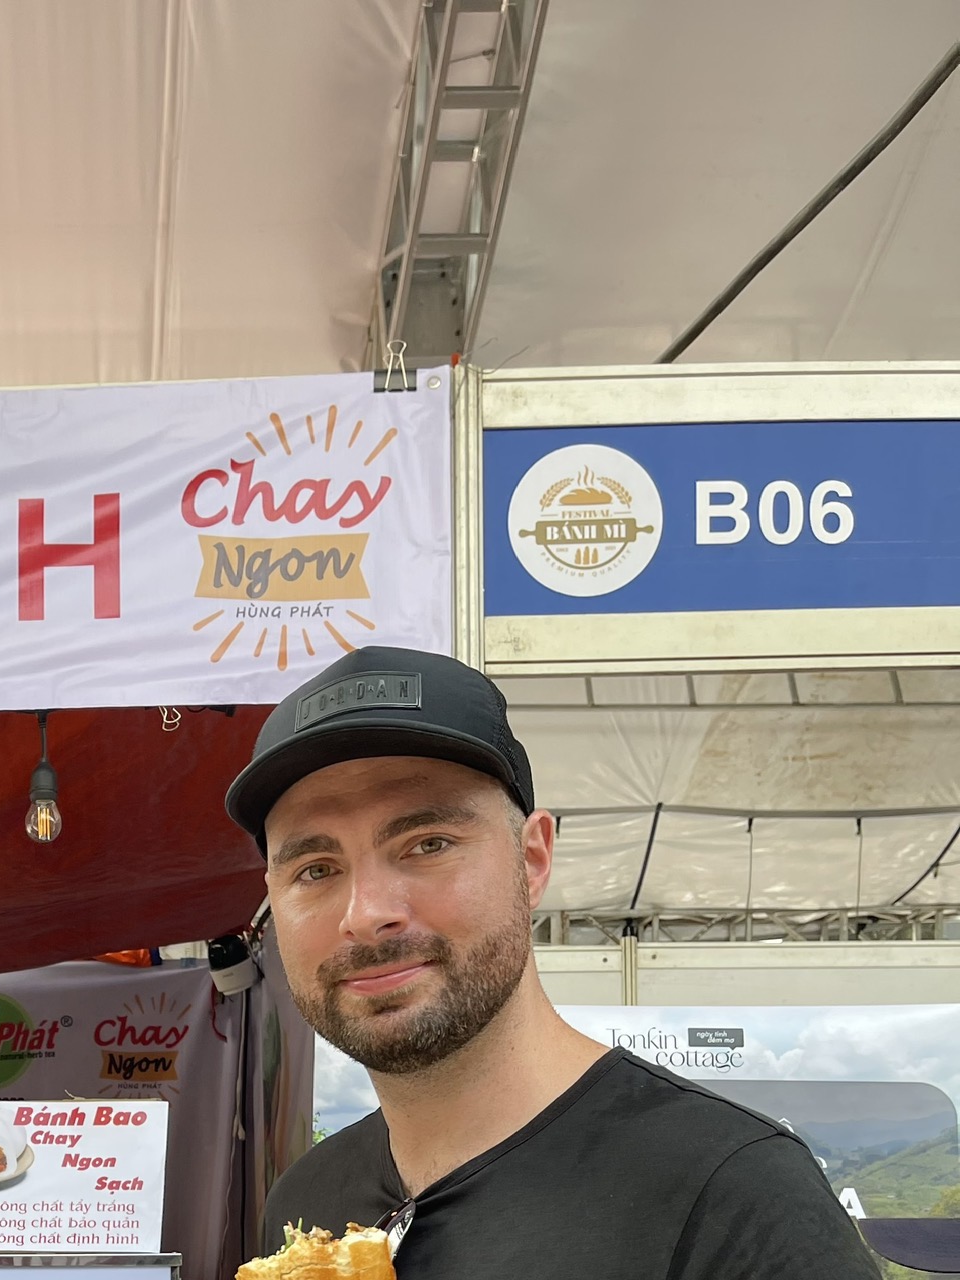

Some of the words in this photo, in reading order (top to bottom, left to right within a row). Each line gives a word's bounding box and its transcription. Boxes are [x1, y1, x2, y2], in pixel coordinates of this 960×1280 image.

[181, 457, 392, 529] Chay
[561, 509, 613, 519] FESTIVAL
[695, 479, 855, 546] B06
[545, 521, 597, 541] BÁNH
[603, 519, 627, 539] MÌ
[212, 541, 356, 599] Ngon
[235, 602, 281, 619] HÙNG
[289, 602, 335, 618] PHÁT
[94, 1015, 189, 1048] Chay
[605, 1026, 679, 1050] Tonkin
[107, 1053, 173, 1080] Ngon
[655, 1050, 745, 1074] cottage
[13, 1105, 87, 1126] Bánh
[92, 1105, 148, 1127] Bao
[30, 1130, 82, 1148] Chay
[61, 1153, 117, 1171] Ngon
[94, 1176, 144, 1195] Sạch
[32, 1198, 64, 1213] chất
[31, 1215, 62, 1229] chất
[68, 1216, 97, 1229] bảo
[101, 1216, 140, 1231] quản
[29, 1231, 61, 1244] chất
[66, 1232, 100, 1247] định
